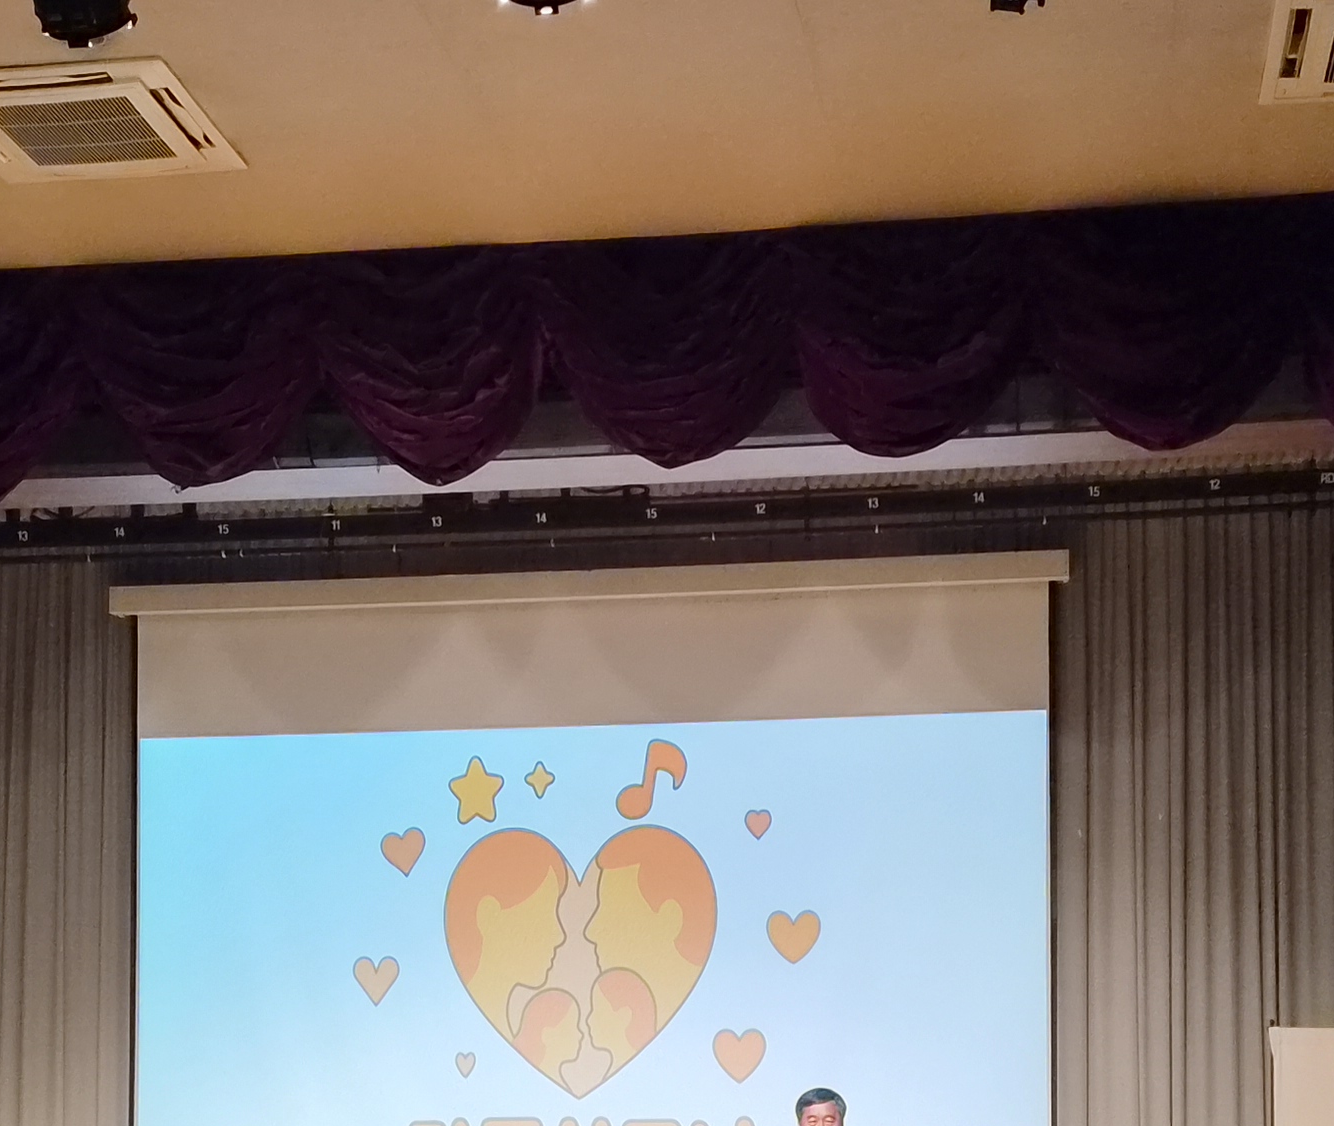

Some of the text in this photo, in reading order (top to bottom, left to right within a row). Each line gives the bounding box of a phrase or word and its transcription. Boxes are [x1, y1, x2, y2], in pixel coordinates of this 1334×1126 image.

[17, 531, 28, 542] 13
[114, 527, 125, 537] 14
[218, 524, 229, 535] 15
[331, 519, 341, 530] 11
[431, 516, 442, 527] 13
[535, 512, 547, 523] 14
[646, 508, 657, 519] 15
[755, 503, 766, 514] 12
[867, 497, 879, 508] 13
[973, 492, 985, 503] 14
[1088, 486, 1100, 497] 15
[1209, 479, 1221, 490] 12
